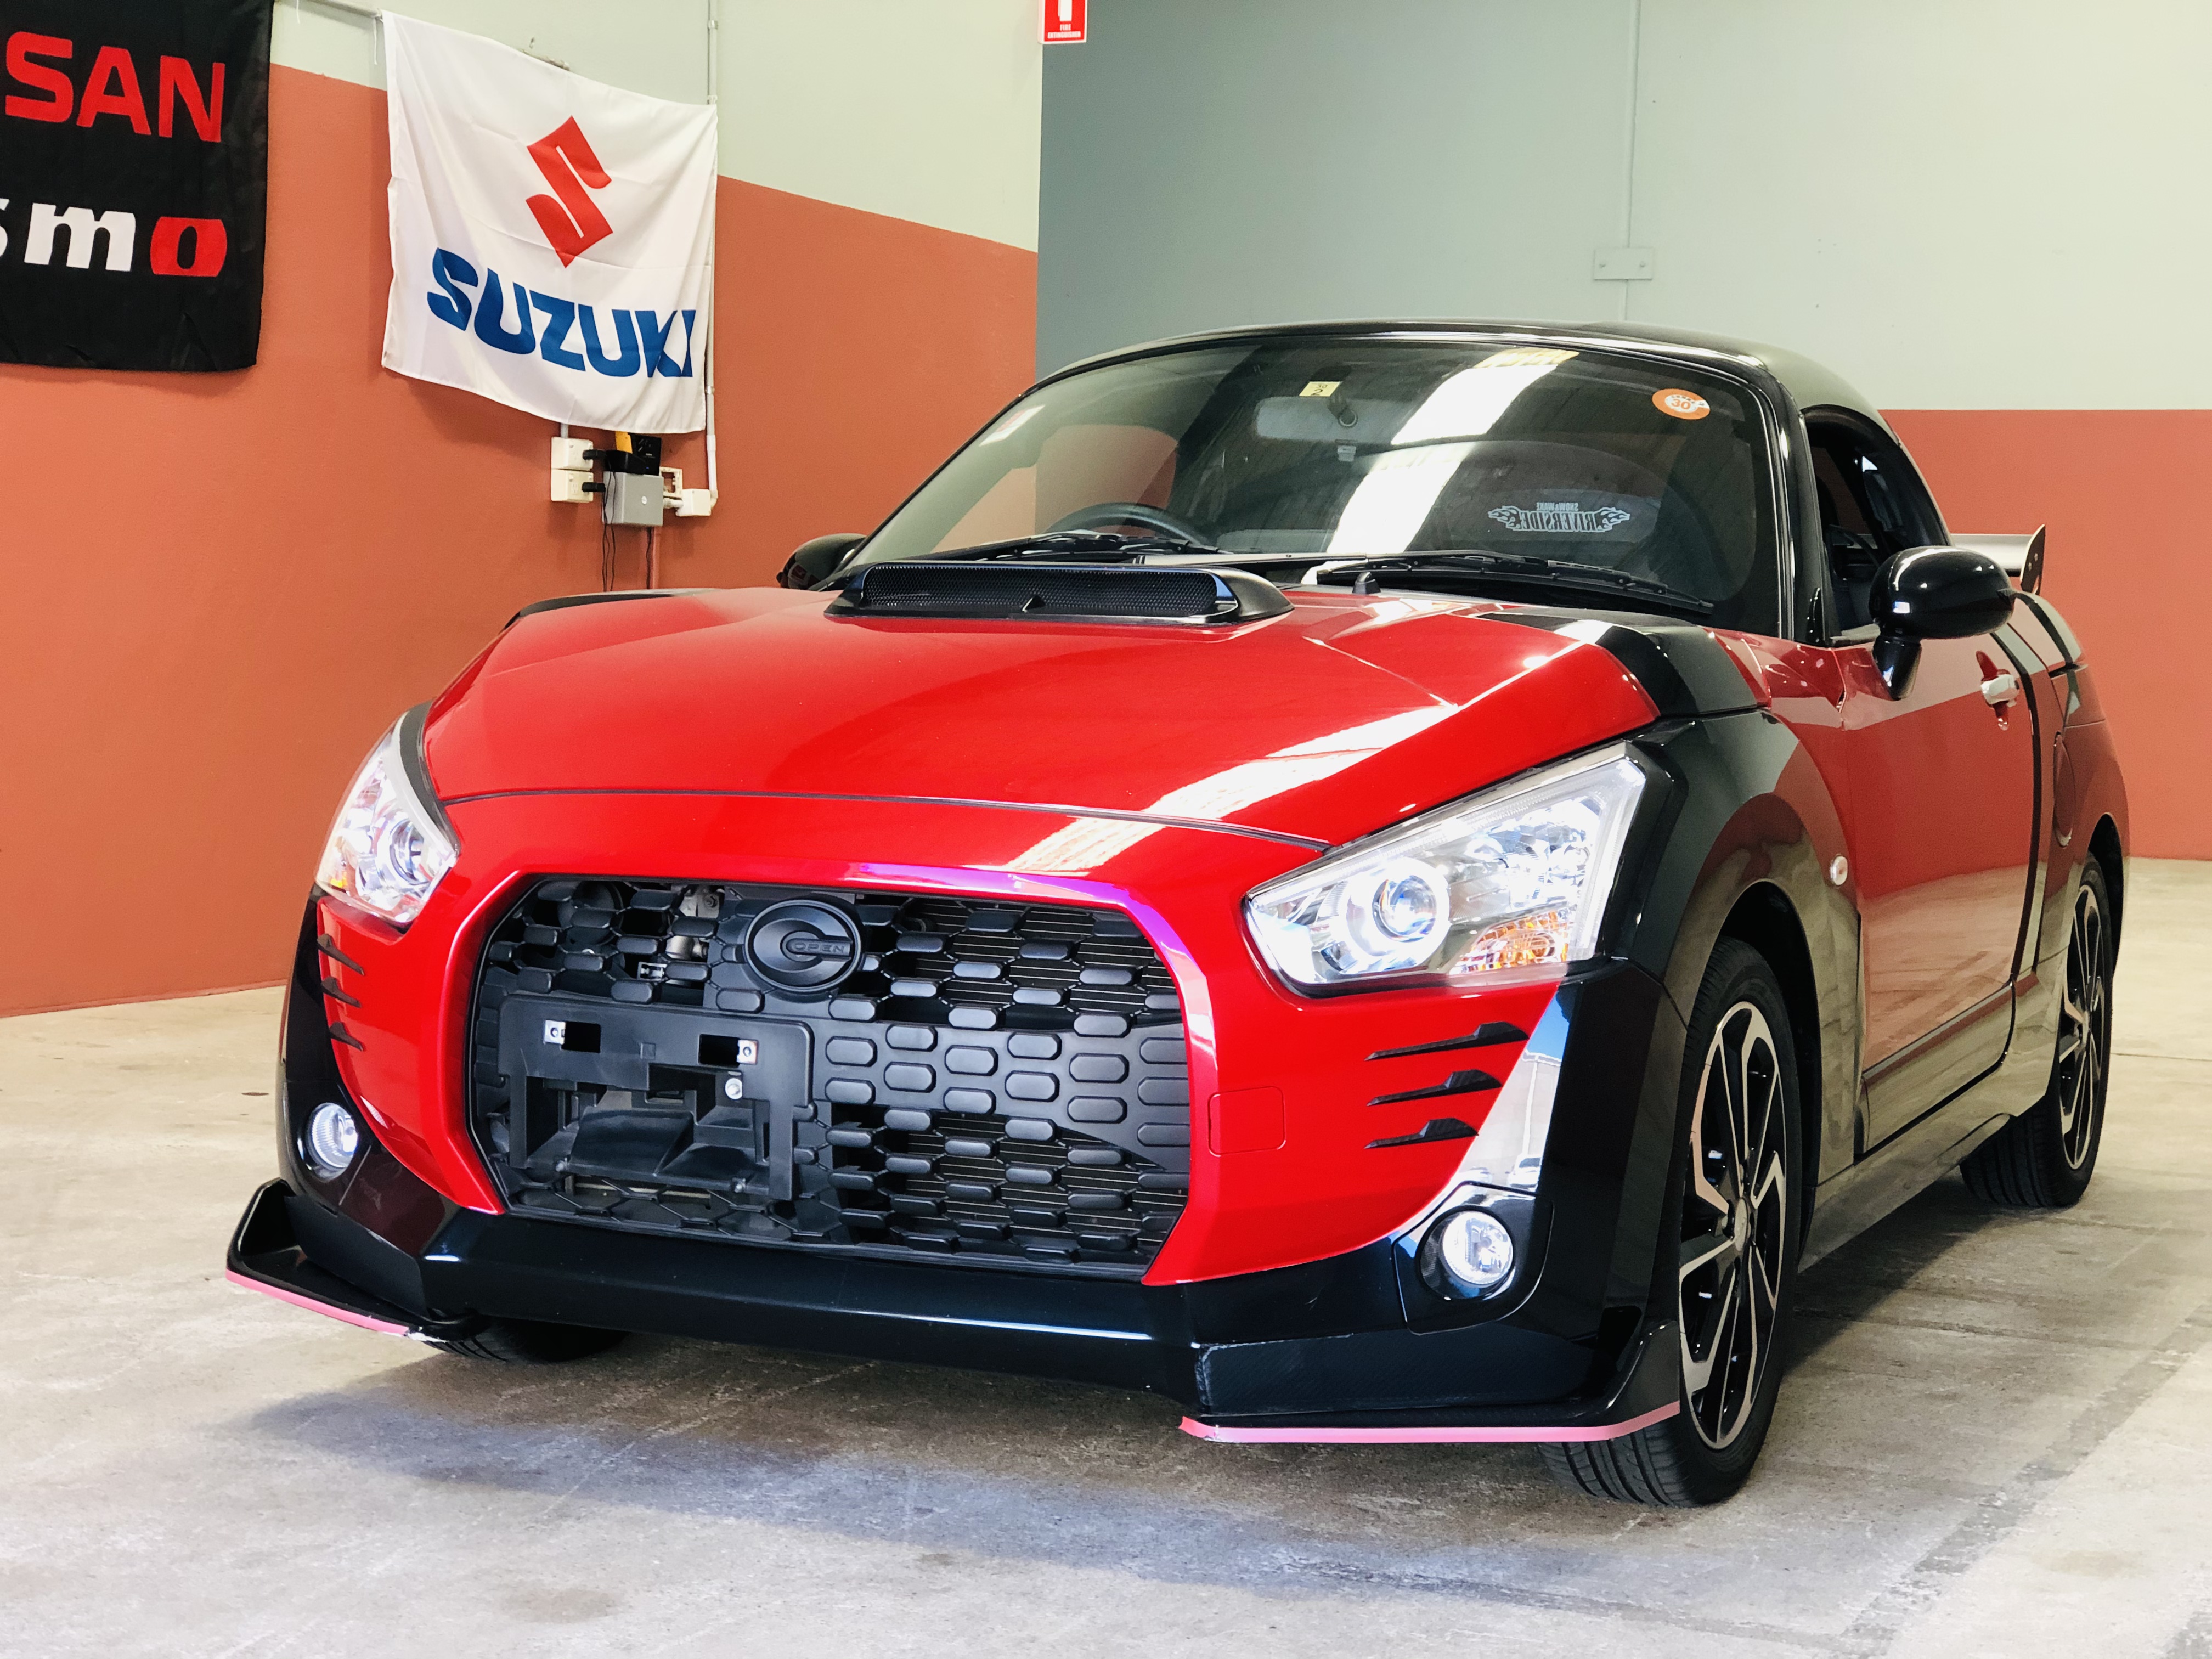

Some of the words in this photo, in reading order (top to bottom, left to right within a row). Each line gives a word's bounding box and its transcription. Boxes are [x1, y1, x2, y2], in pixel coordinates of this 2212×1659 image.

[5, 31, 225, 143] SAN
[0, 198, 228, 277] mo
[427, 247, 696, 378] SUZUKI
[1672, 399, 1691, 409] 30
[795, 943, 844, 952] OPEN
